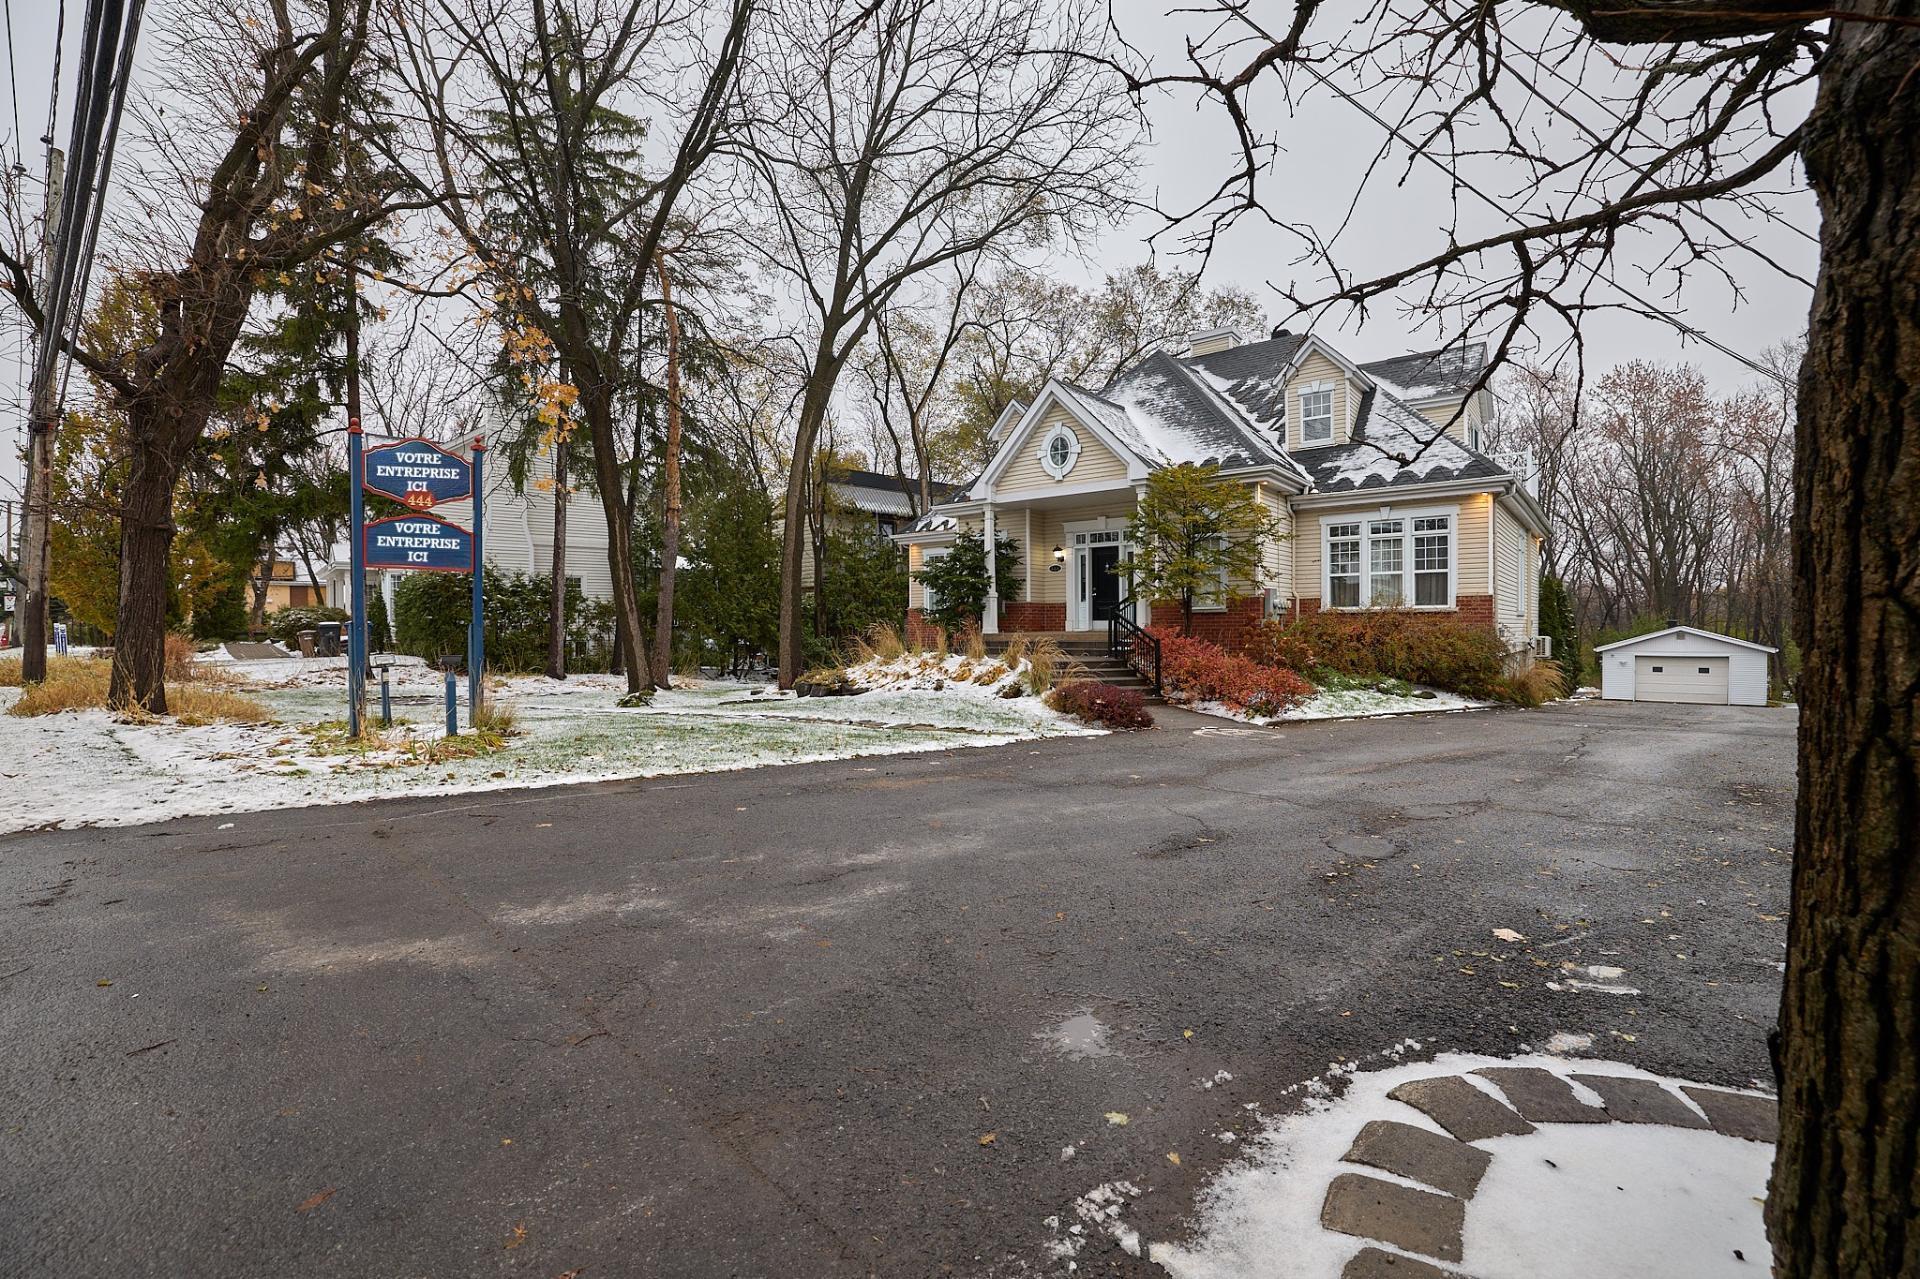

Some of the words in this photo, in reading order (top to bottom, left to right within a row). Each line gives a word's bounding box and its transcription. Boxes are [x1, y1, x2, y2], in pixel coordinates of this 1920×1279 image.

[396, 452, 441, 464] VOTRE
[376, 466, 459, 479] ENTREPRISE
[407, 481, 427, 491] ICI
[407, 494, 432, 506] 444
[395, 523, 440, 534] VOTRE
[377, 536, 460, 549] ENTREPRISE
[408, 552, 428, 562] ICI
